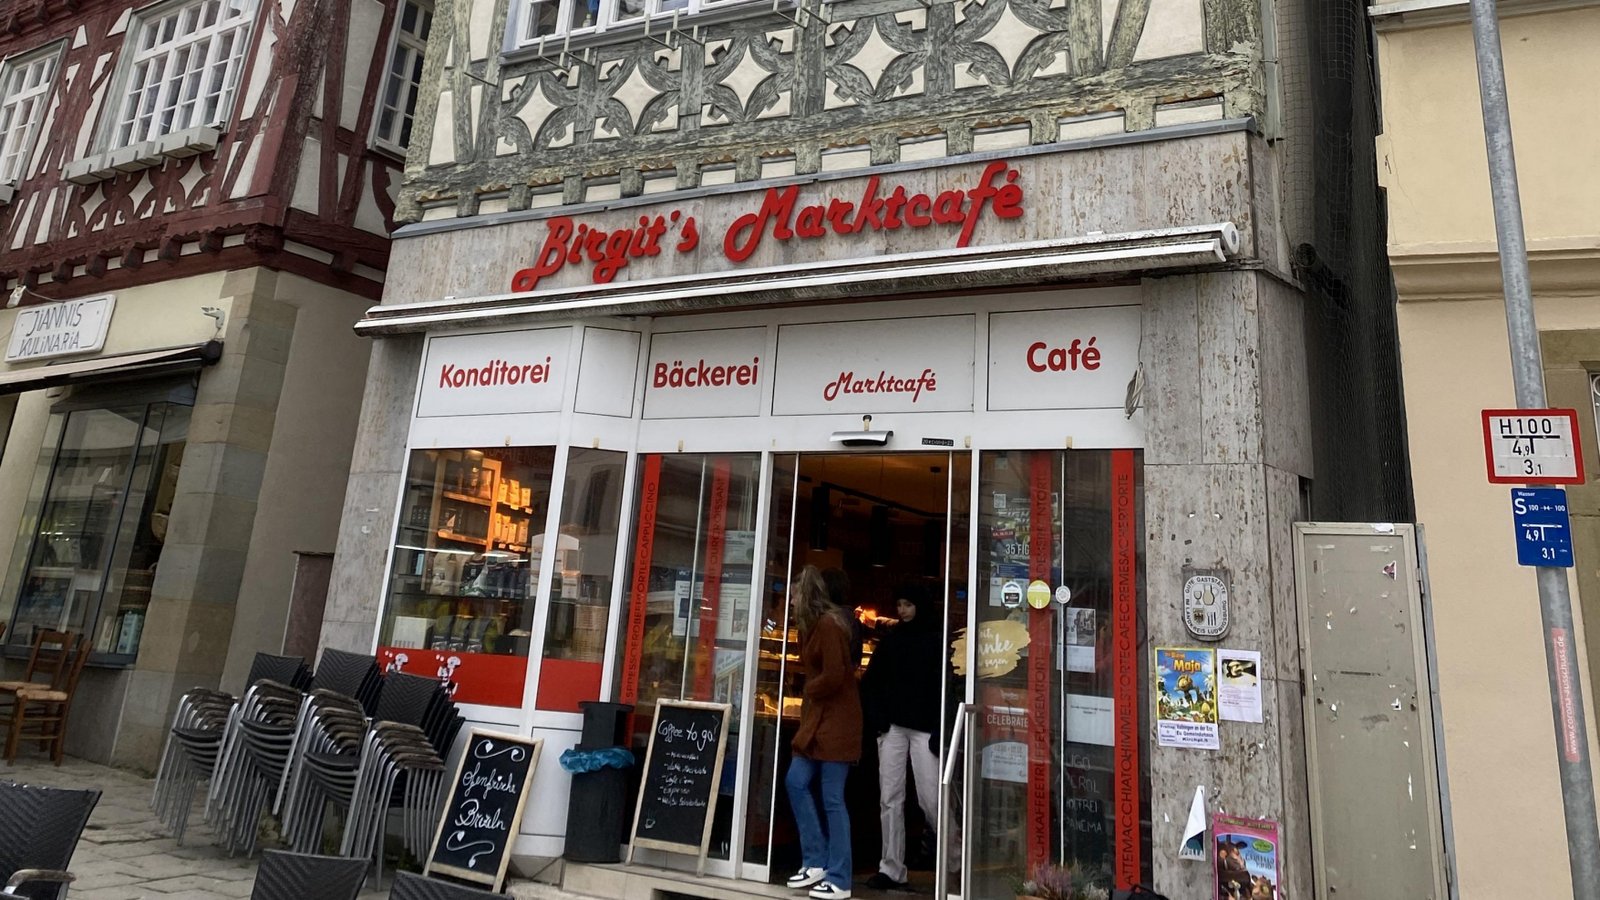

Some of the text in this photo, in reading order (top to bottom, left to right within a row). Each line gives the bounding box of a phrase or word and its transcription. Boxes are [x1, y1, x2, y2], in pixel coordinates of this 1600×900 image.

[511, 161, 1025, 293] Birgit's Marktcafé
[1026, 336, 1102, 373] Café
[439, 356, 552, 389] Konditorei
[652, 356, 760, 389] Bäckerei
[823, 368, 937, 403] Marktcafé
[1514, 498, 1527, 515] S
[1185, 580, 1195, 594] GUTE
[1186, 606, 1206, 634] LANDKREIS
[1207, 600, 1228, 635] LUDWIGSBURG
[1173, 659, 1201, 673] Maja
[657, 719, 683, 743] Coffee
[686, 722, 698, 741] to
[986, 713, 1029, 728] CELEBRATE
[462, 762, 516, 800] Ofenfrische
